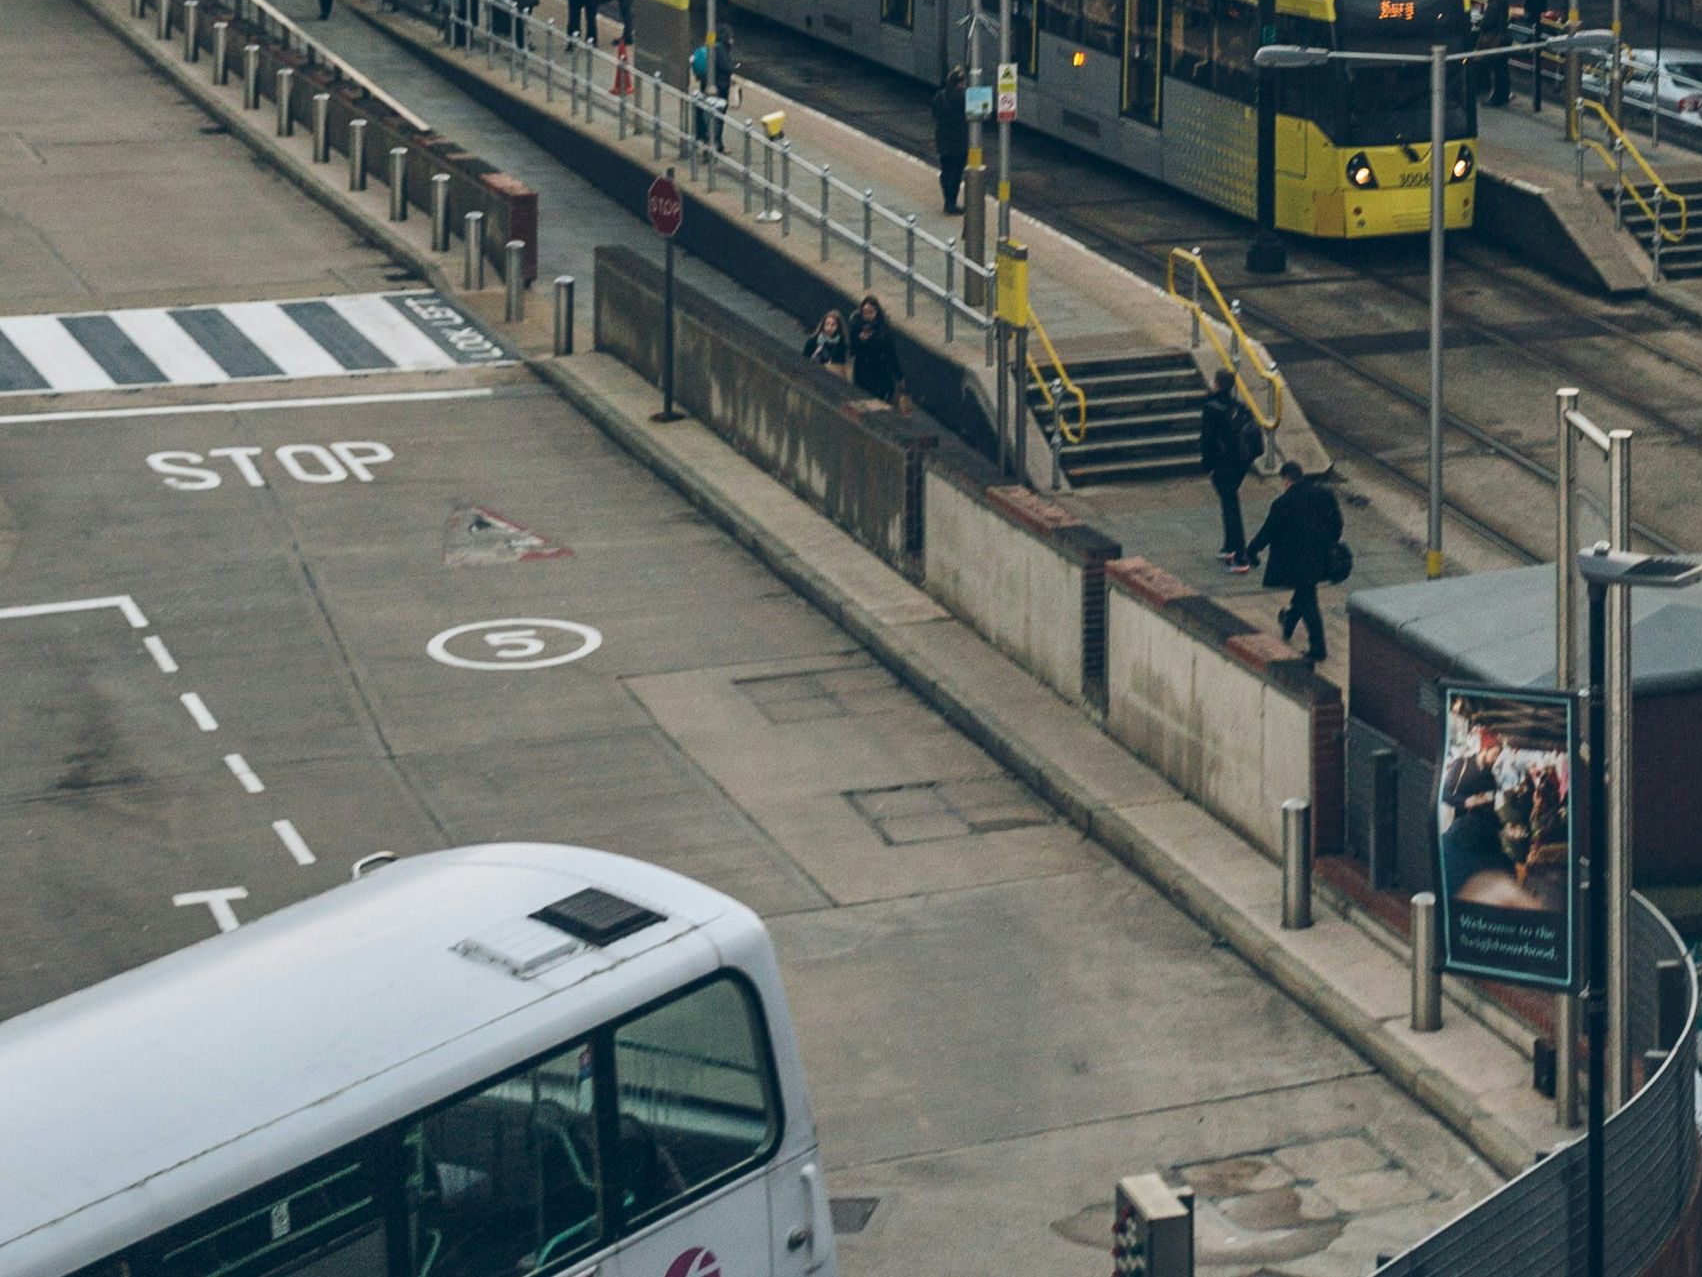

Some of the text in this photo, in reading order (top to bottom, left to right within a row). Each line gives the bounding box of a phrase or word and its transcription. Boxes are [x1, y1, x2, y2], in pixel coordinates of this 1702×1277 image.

[650, 196, 681, 216] STOP
[404, 296, 505, 360] LOOK LEFT
[145, 441, 395, 490] STOP
[484, 629, 546, 658] 5
[1459, 914, 1556, 940] Welcome to the
